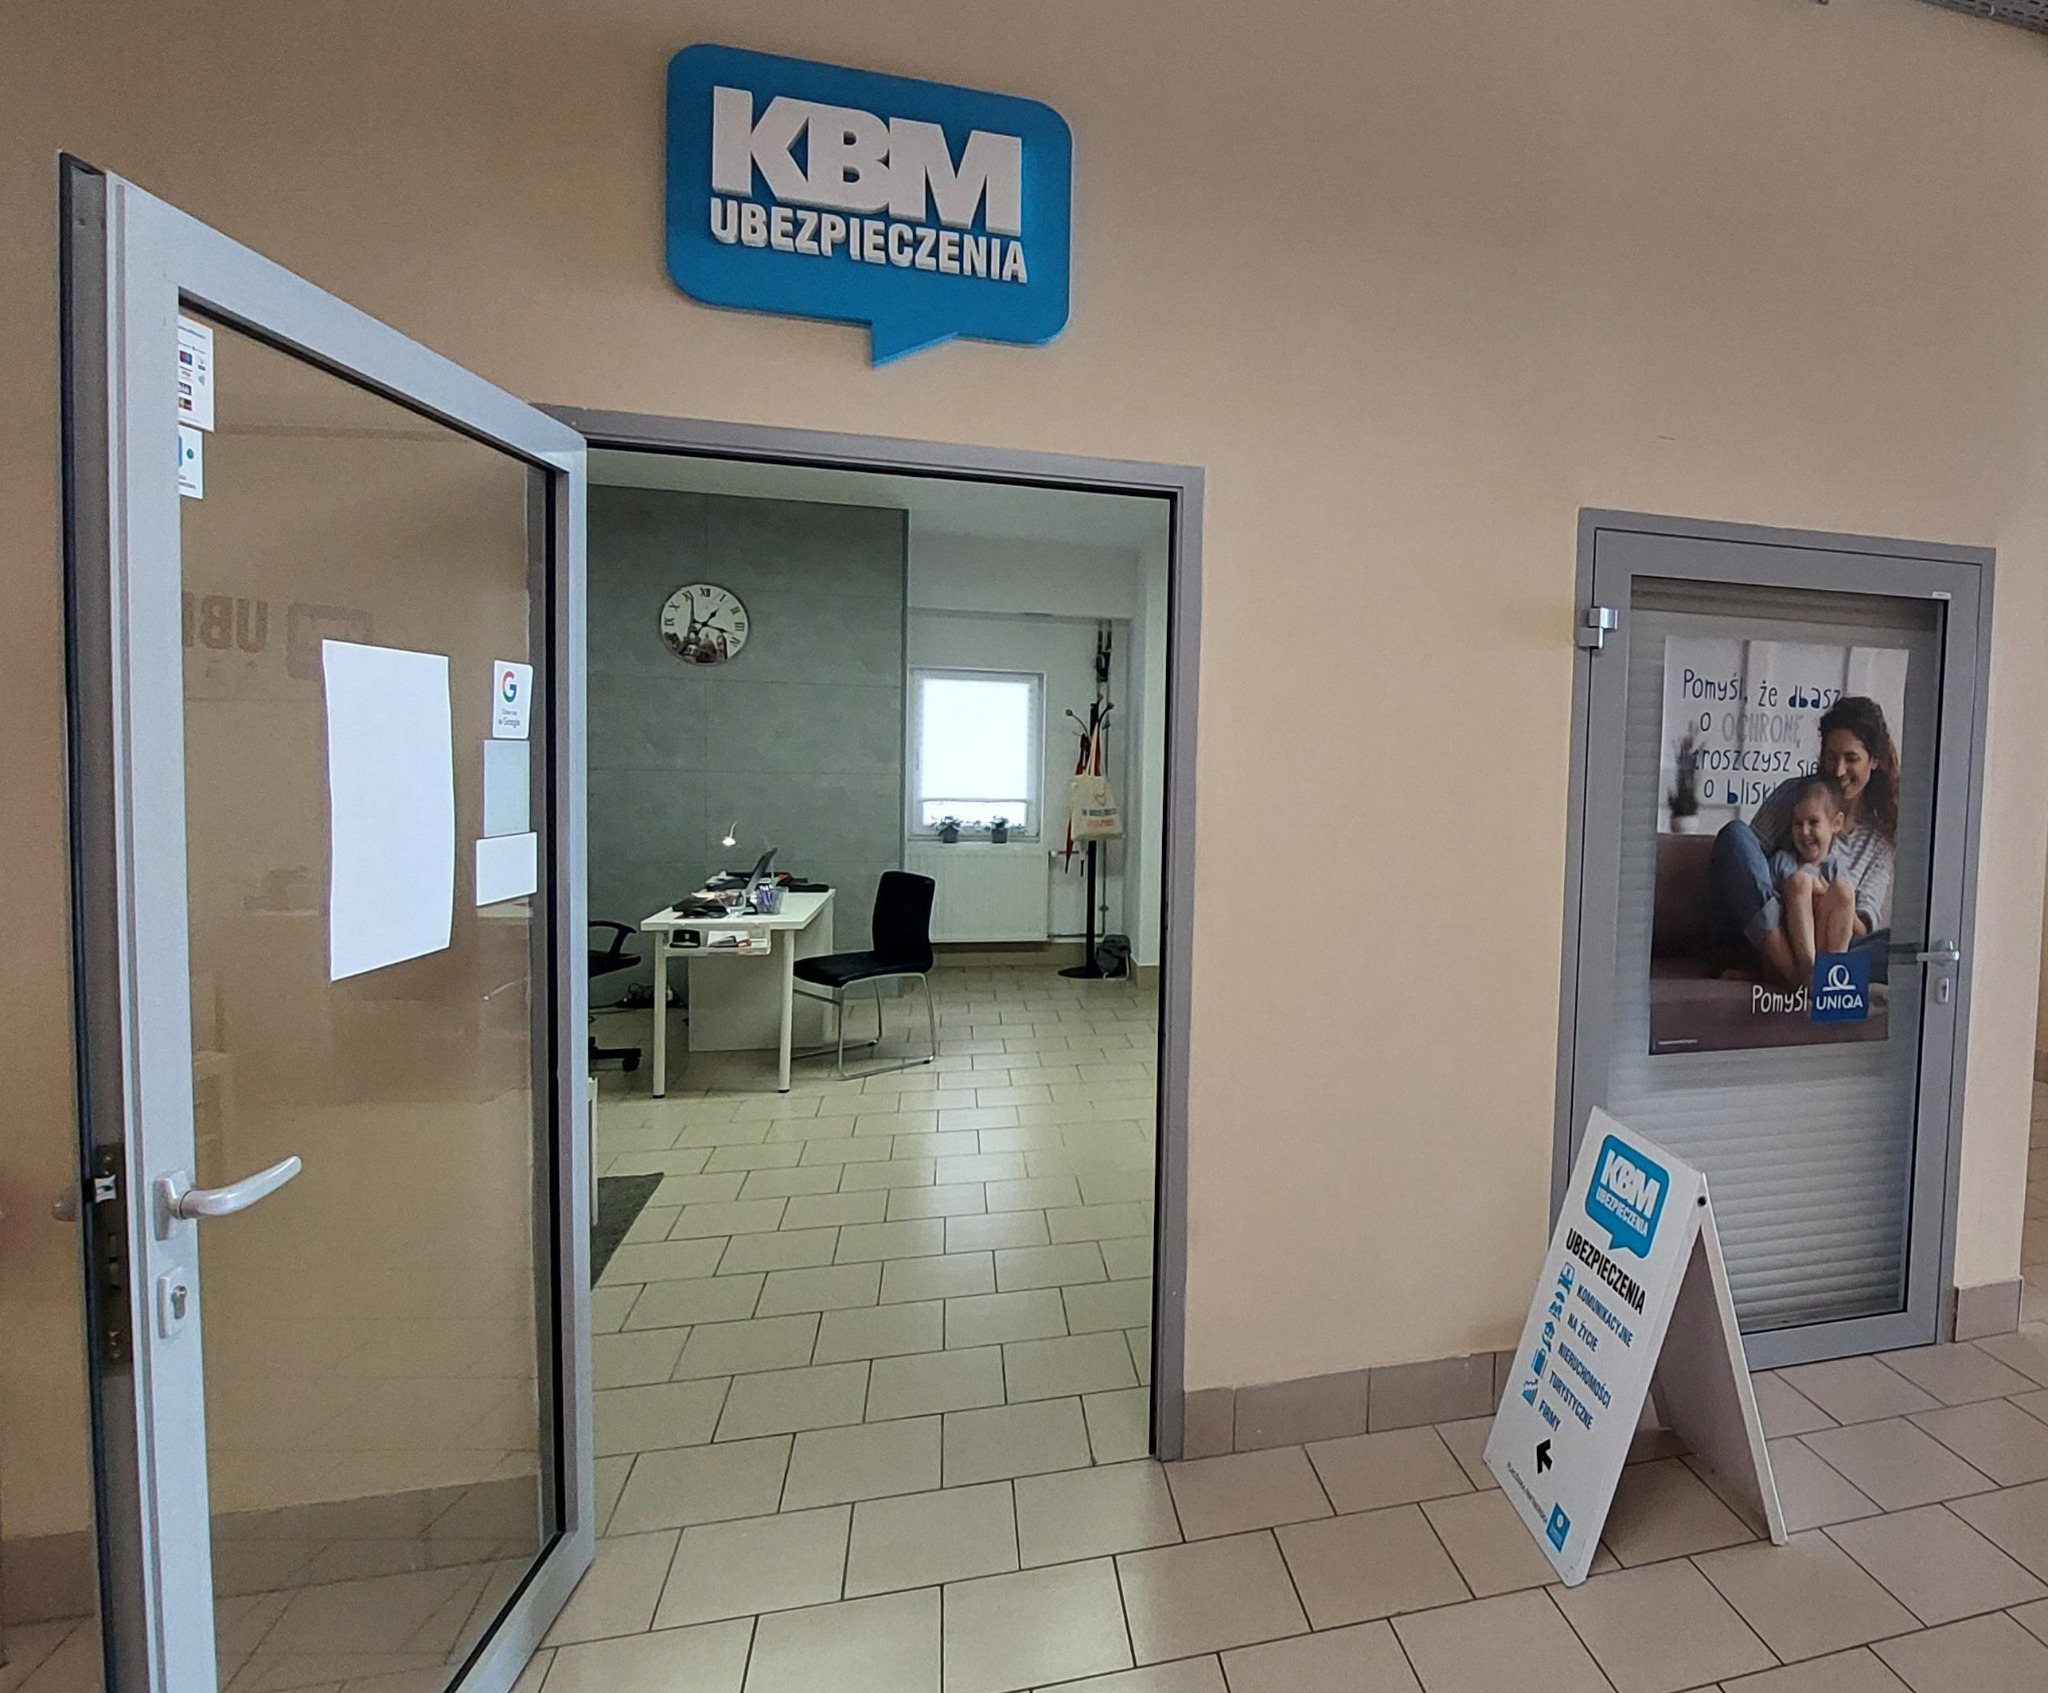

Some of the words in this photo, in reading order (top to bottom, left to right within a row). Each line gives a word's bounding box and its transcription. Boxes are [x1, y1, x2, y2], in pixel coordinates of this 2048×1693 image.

[712, 85, 1022, 237] KBM
[709, 197, 1028, 284] UBEZPIECZENIA
[1683, 668, 1748, 705] Pomyśl,
[1758, 680, 1778, 707] że
[1700, 711, 1711, 732] o
[1693, 749, 1792, 773] troszczysz
[1703, 779, 1714, 798] o
[1752, 984, 1808, 1014] Pomyśl
[1815, 994, 1863, 1011] UNIQA
[1600, 1148, 1661, 1219] KBM
[1566, 1227, 1646, 1315] UBEZPIECZENIA
[1567, 1312, 1578, 1333] NA
[1577, 1320, 1599, 1352] ŻYCIE
[1577, 1284, 1634, 1348] KOMUNIKACYJNE
[1558, 1341, 1612, 1409] NIERUCHOMOŚCI
[1538, 1399, 1561, 1432] FIRMY
[1549, 1369, 1594, 1431] TURYSTYCZNE
